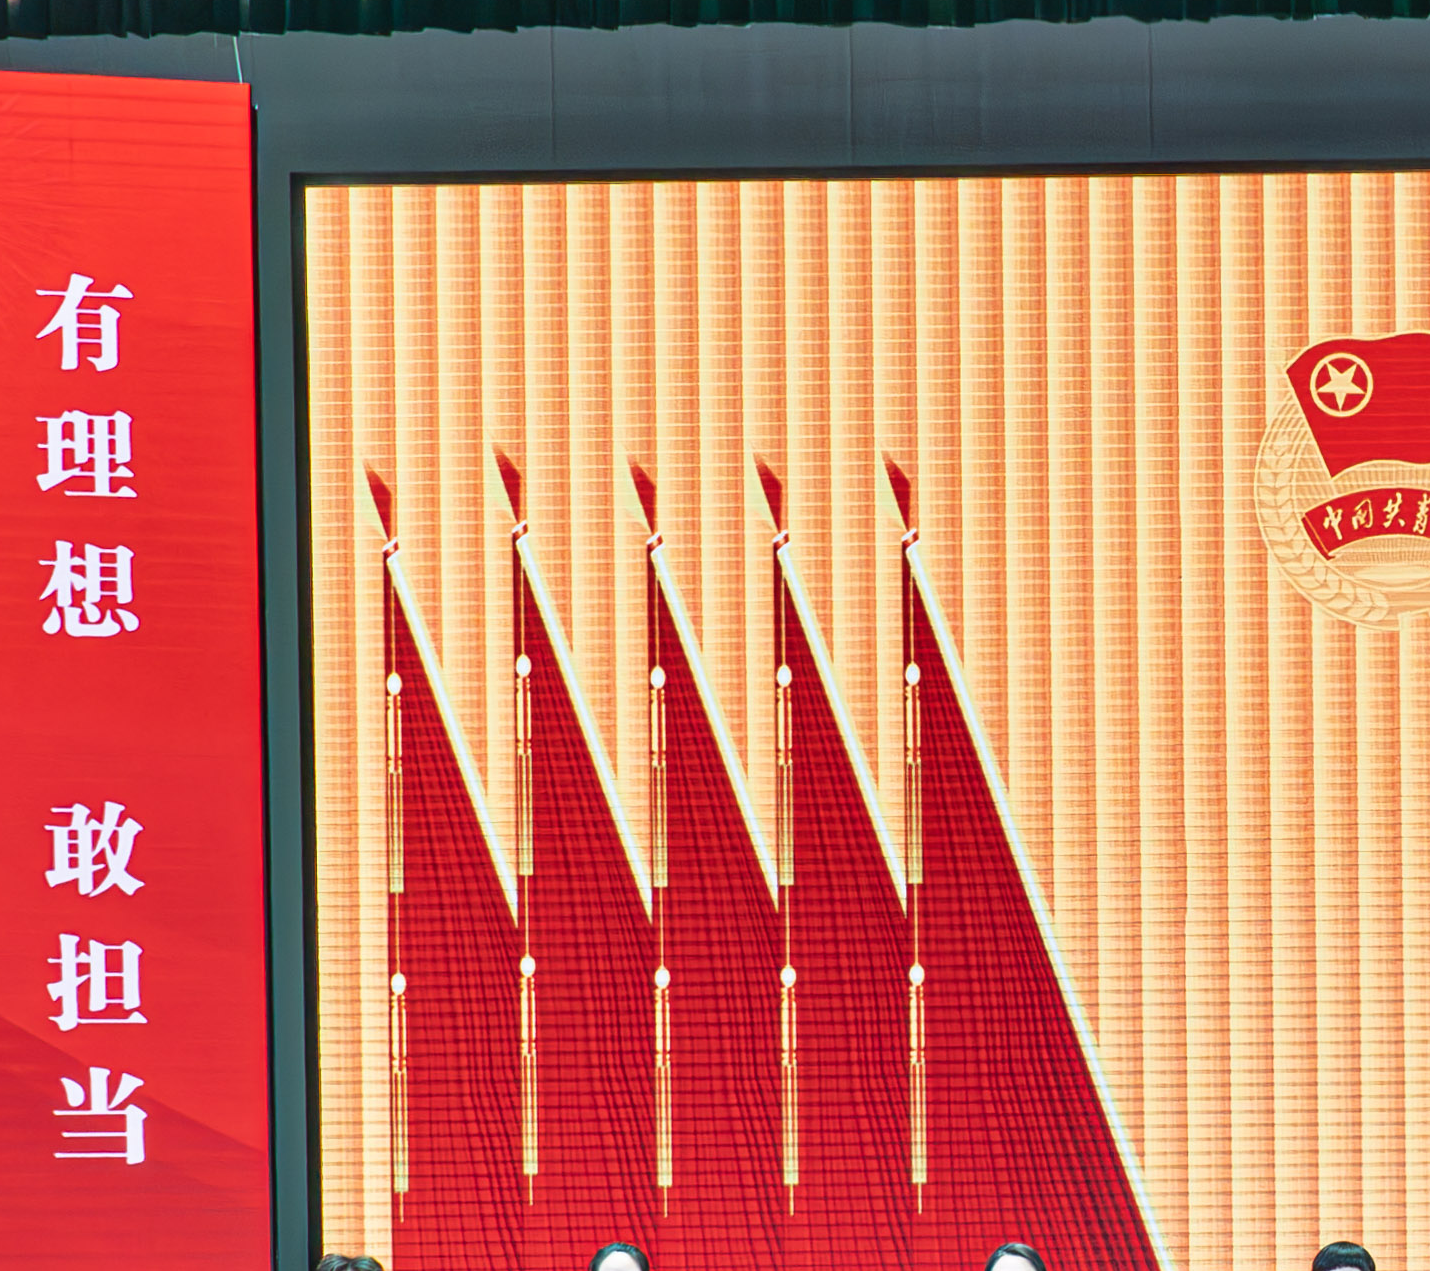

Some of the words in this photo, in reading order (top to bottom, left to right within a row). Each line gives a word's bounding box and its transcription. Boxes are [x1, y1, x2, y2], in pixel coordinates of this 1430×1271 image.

[35, 273, 139, 637] 有理想
[45, 801, 147, 1165] 敢担当
